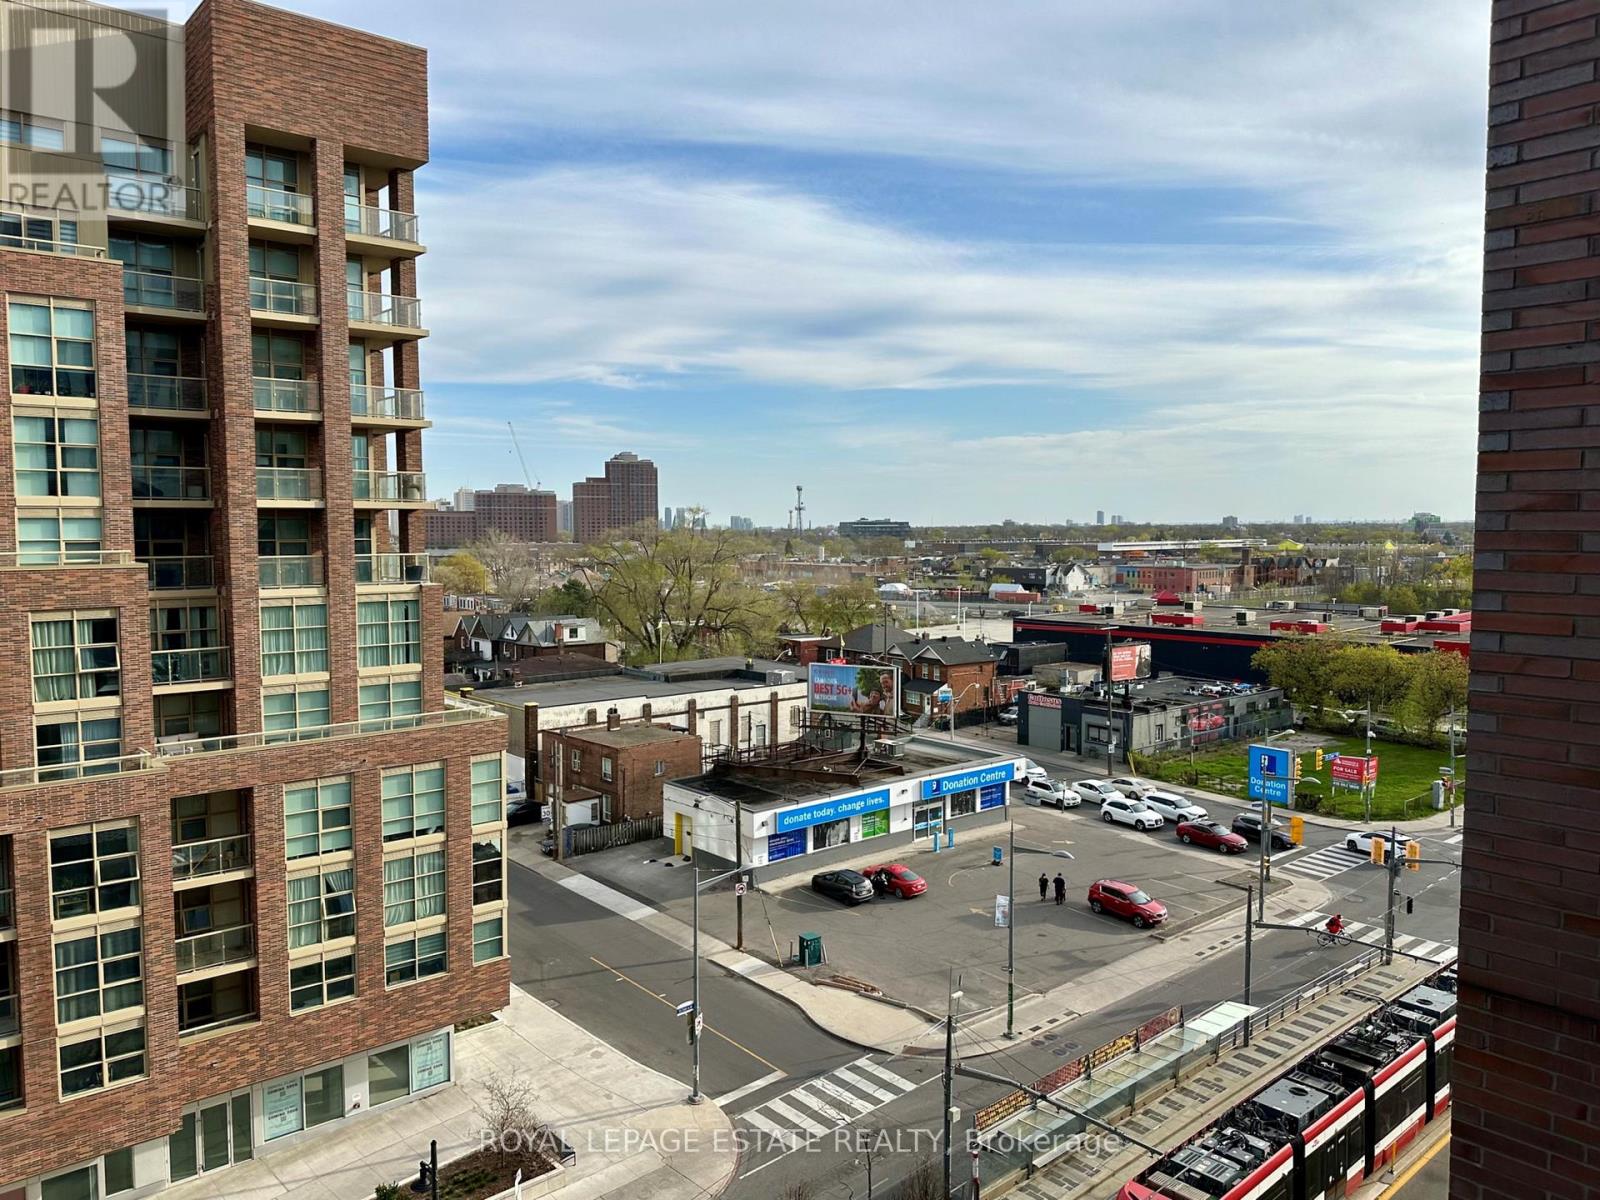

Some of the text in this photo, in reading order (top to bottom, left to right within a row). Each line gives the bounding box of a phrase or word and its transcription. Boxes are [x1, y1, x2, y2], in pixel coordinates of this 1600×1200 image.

[814, 683, 853, 696] BEST 5G+
[943, 770, 1006, 791] Donation Centre
[783, 796, 885, 825] donate today. change lives.
